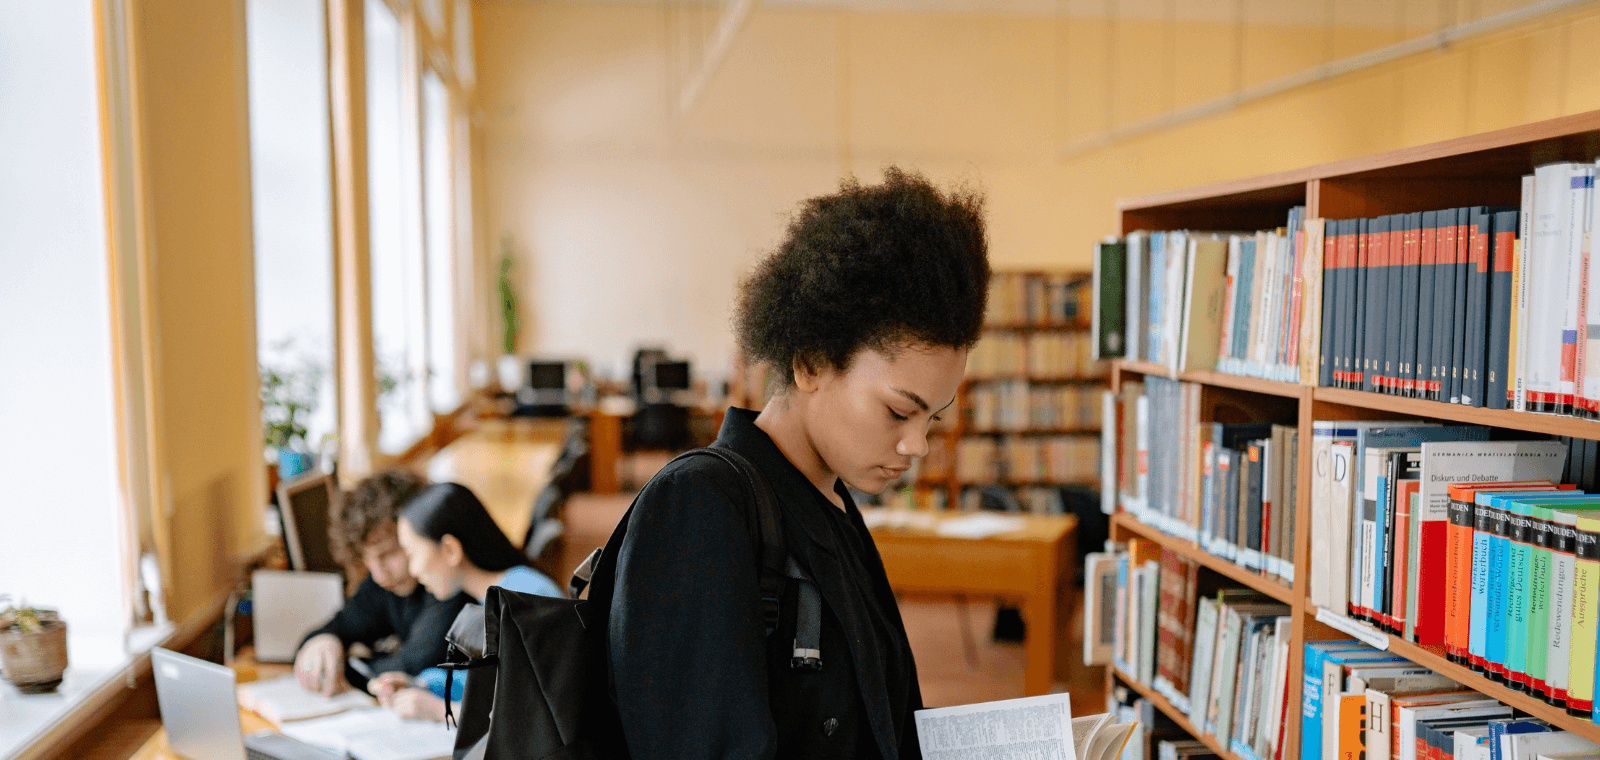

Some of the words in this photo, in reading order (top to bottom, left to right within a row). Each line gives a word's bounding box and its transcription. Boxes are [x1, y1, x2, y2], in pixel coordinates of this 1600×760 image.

[1316, 451, 1328, 479] C
[1333, 453, 1347, 482] D
[1431, 474, 1455, 482] Diskurs
[1456, 474, 1470, 482] und
[1471, 474, 1499, 482] Debatte
[1455, 514, 1459, 522] 5
[1495, 524, 1500, 532] 8
[1515, 530, 1520, 538] 9
[1553, 526, 1577, 538] DUDEN
[1559, 539, 1566, 549] 11
[1577, 546, 1584, 555] 12
[1515, 549, 1524, 592] Deutsch
[1552, 561, 1566, 649] Redewendungen
[1576, 568, 1588, 629] Aussprüche
[1515, 595, 1523, 623] gutes
[1369, 700, 1383, 733] H
